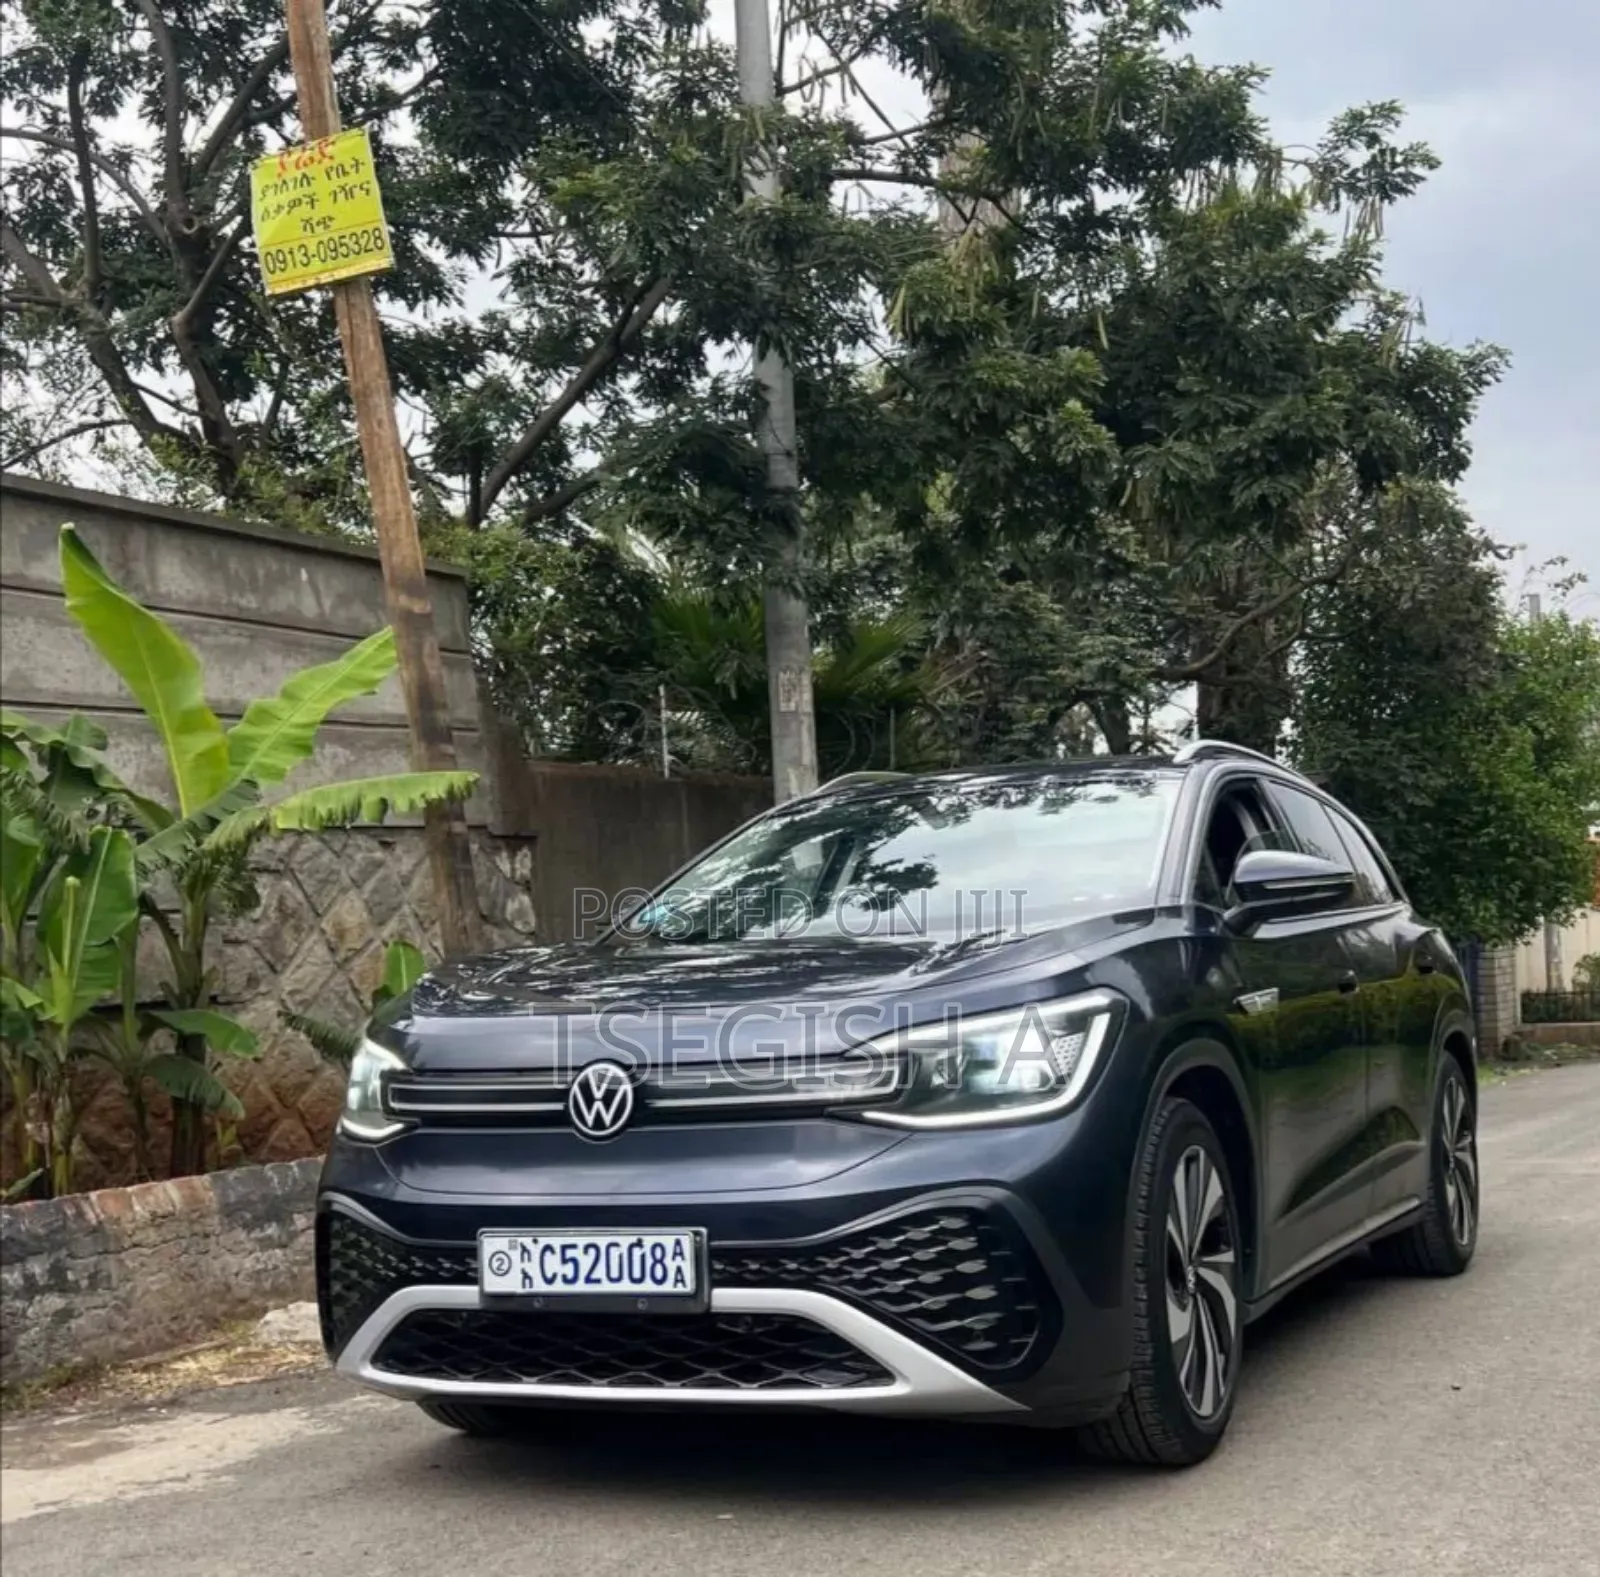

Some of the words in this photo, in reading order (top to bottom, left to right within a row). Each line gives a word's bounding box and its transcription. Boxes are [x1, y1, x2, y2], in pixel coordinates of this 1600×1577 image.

[325, 157, 365, 181] የቤት
[264, 227, 385, 275] 0913-095328
[569, 1063, 633, 1135] VW
[539, 1241, 668, 1286] C52008
